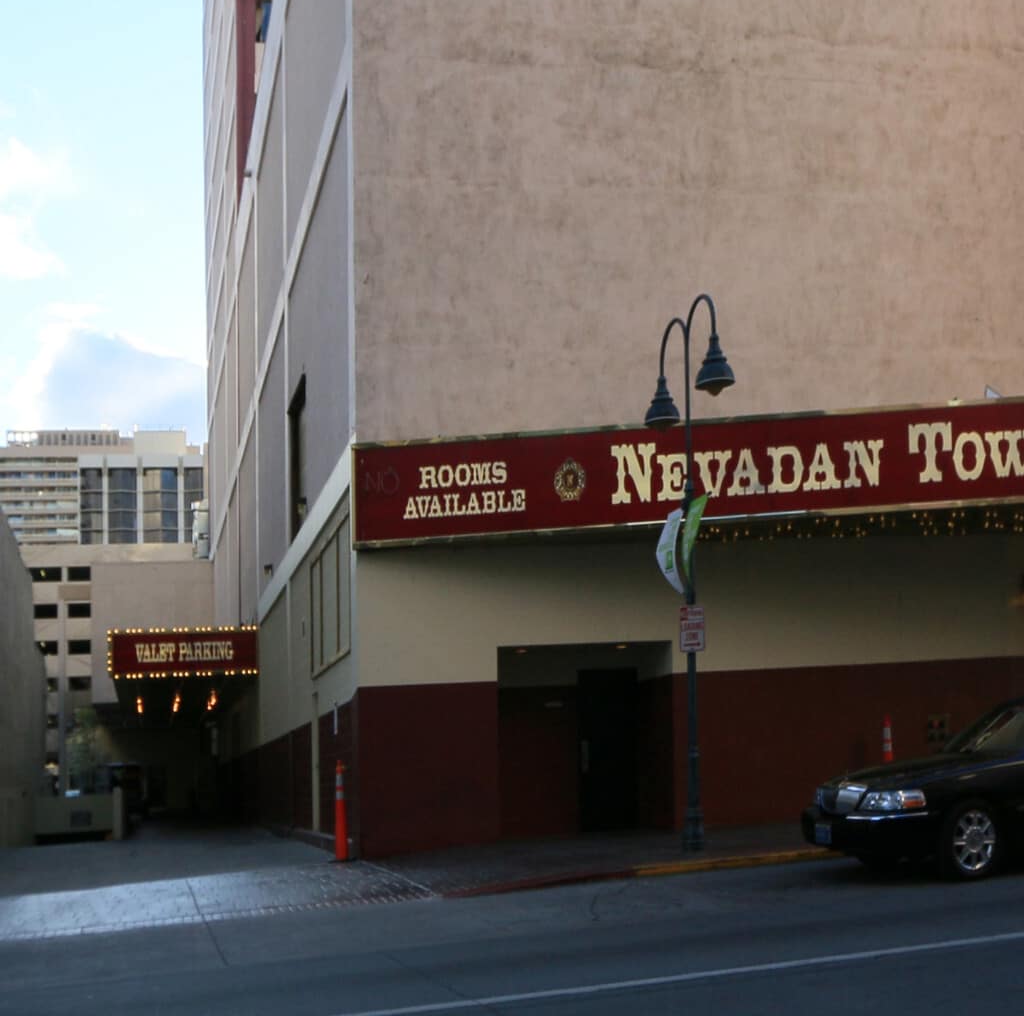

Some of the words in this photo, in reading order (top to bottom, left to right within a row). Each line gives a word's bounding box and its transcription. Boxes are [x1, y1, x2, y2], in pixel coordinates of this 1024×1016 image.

[419, 461, 508, 489] ROOMS
[611, 439, 884, 505] NEVADAN
[403, 489, 527, 519] AVAILABLE
[134, 643, 176, 663] VALET
[178, 641, 234, 662] PARKING
